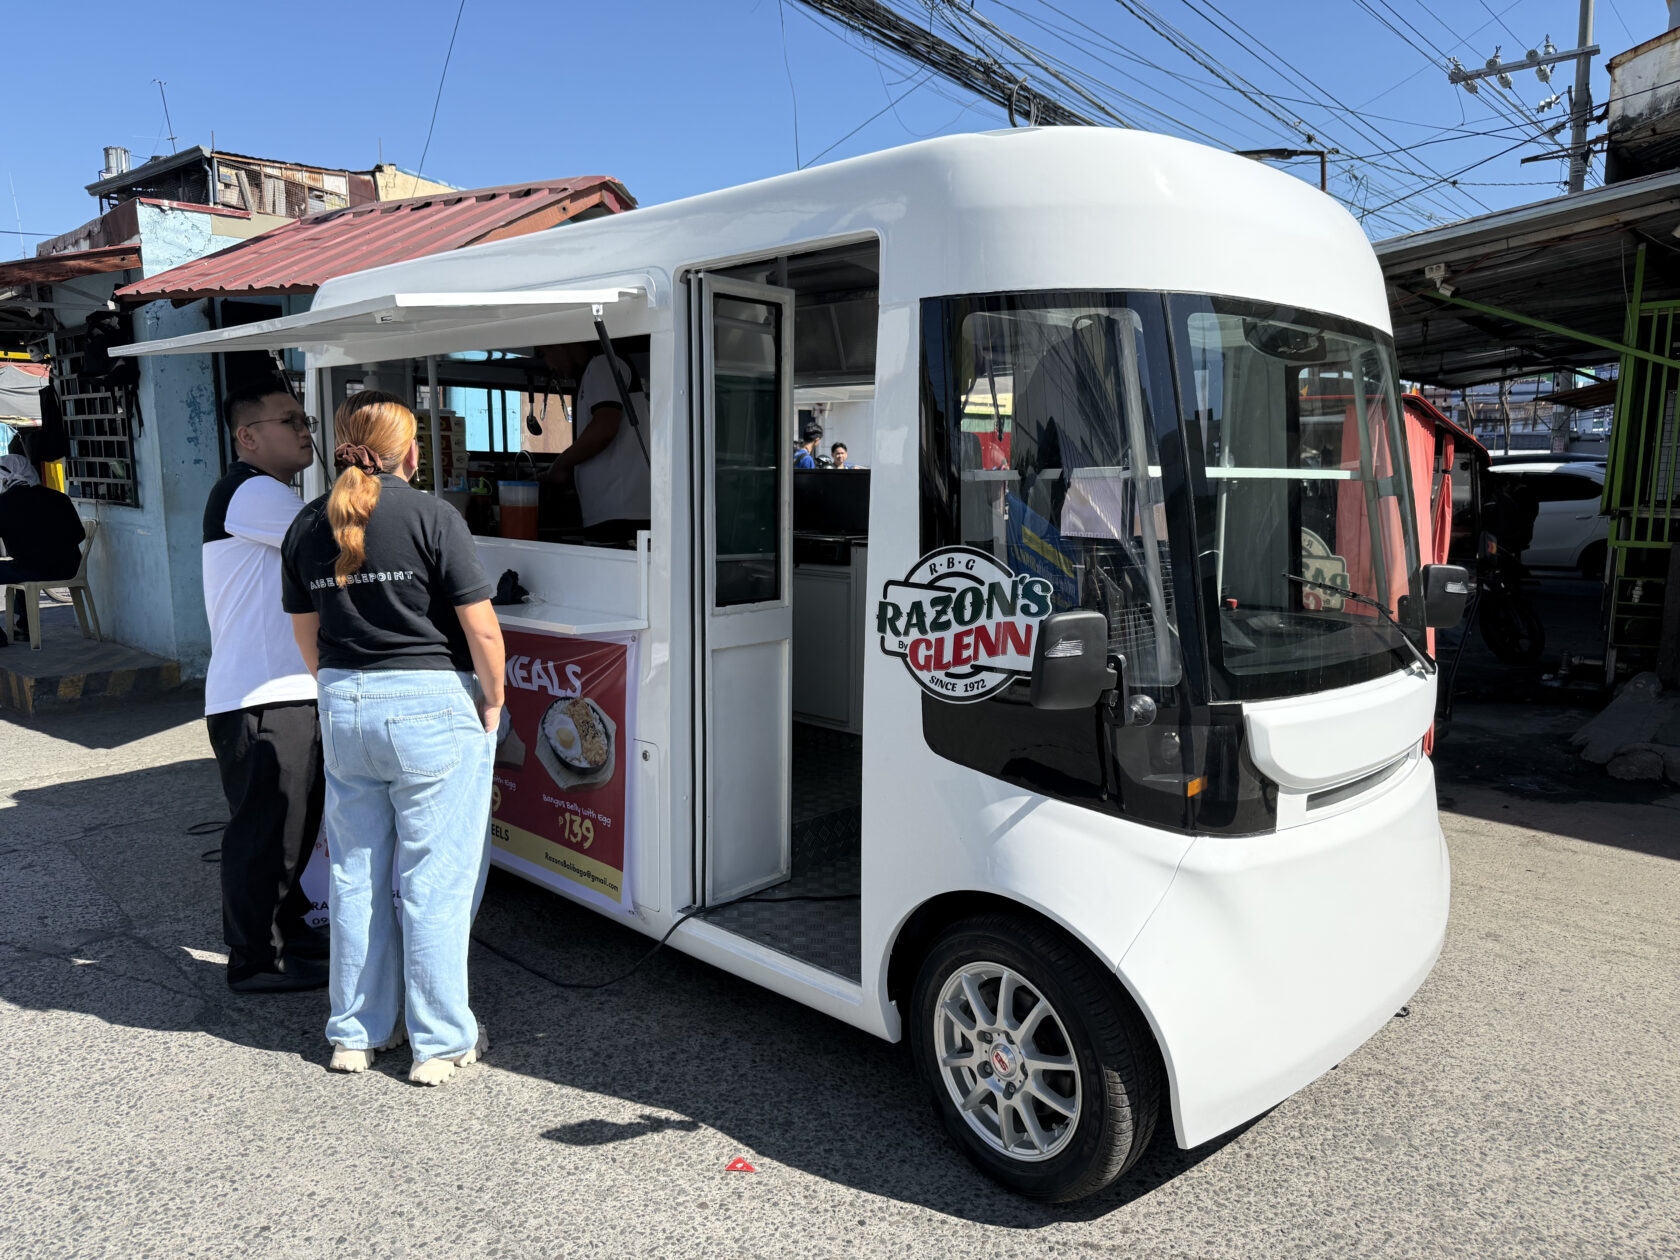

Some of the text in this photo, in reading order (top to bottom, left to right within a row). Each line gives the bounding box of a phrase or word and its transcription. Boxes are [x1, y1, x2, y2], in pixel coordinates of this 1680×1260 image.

[877, 575, 1053, 637] RAZON'S
[898, 621, 1033, 672] By GLENN
[928, 675, 987, 693] SINCE 1972
[542, 793, 612, 828] Bangus Belly with Egg
[491, 823, 510, 842] EELS
